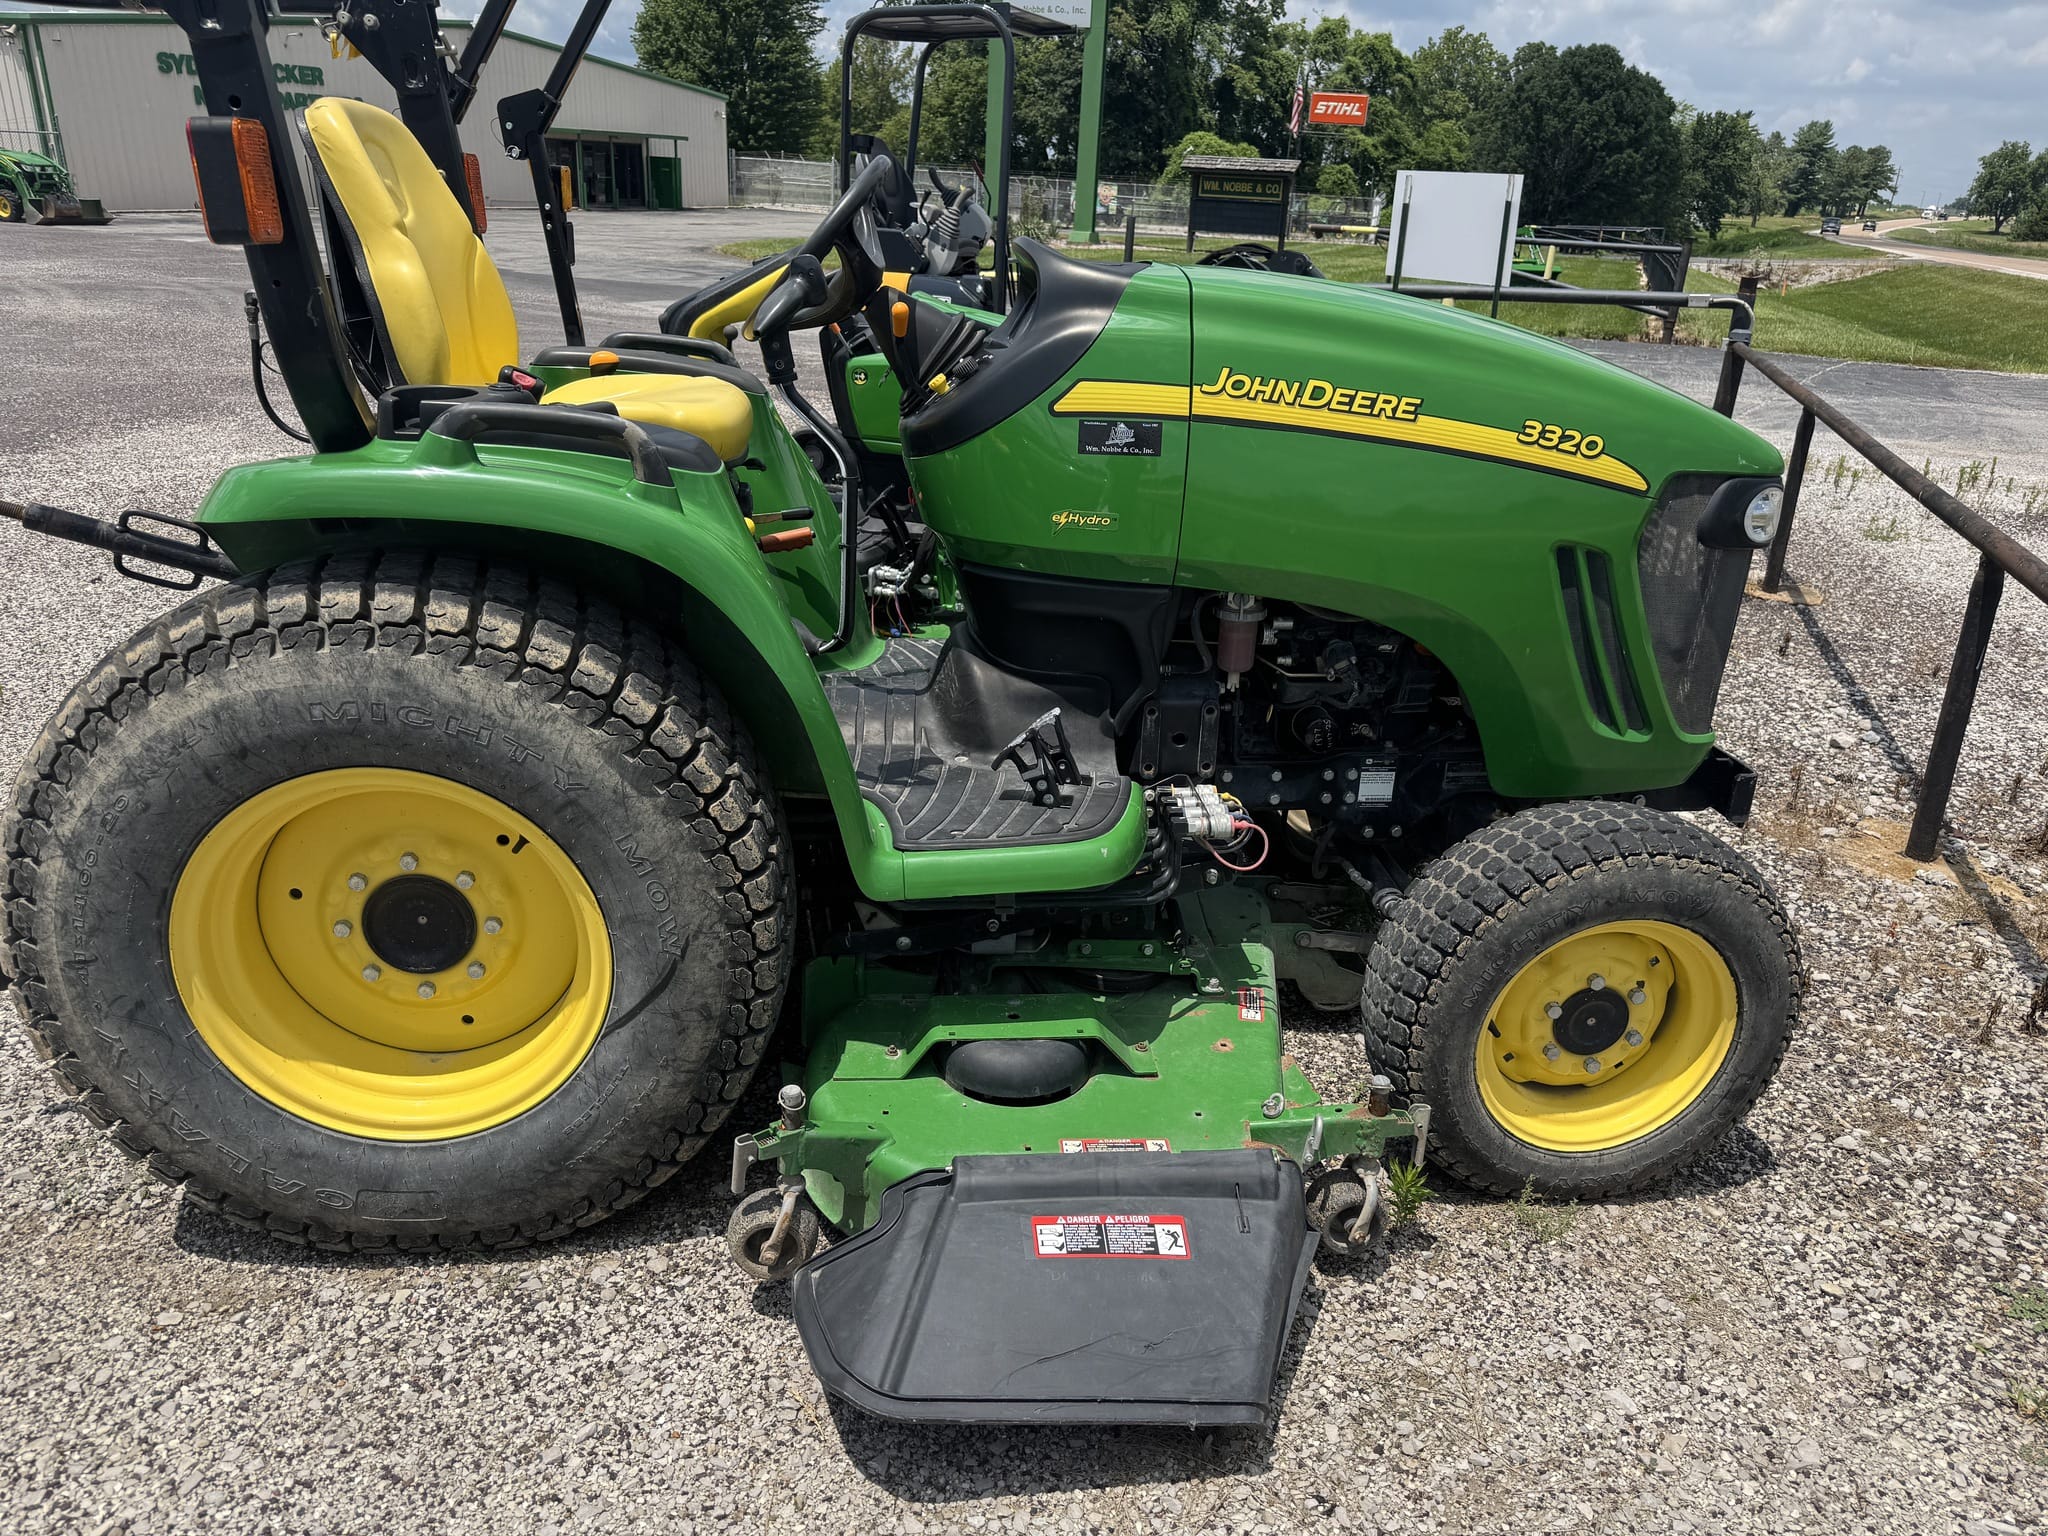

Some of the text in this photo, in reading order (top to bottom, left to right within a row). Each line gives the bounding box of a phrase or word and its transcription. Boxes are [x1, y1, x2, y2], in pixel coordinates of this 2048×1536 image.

[1314, 101, 1362, 116] STIHL
[1223, 181, 1253, 193] NOBBE
[1256, 184, 1262, 193] &
[1200, 366, 1423, 422] JOHN DEERE
[1517, 418, 1605, 459] 3320
[1101, 445, 1122, 453] Nobbe
[1066, 1215, 1150, 1224] DANGER PELIGRO
